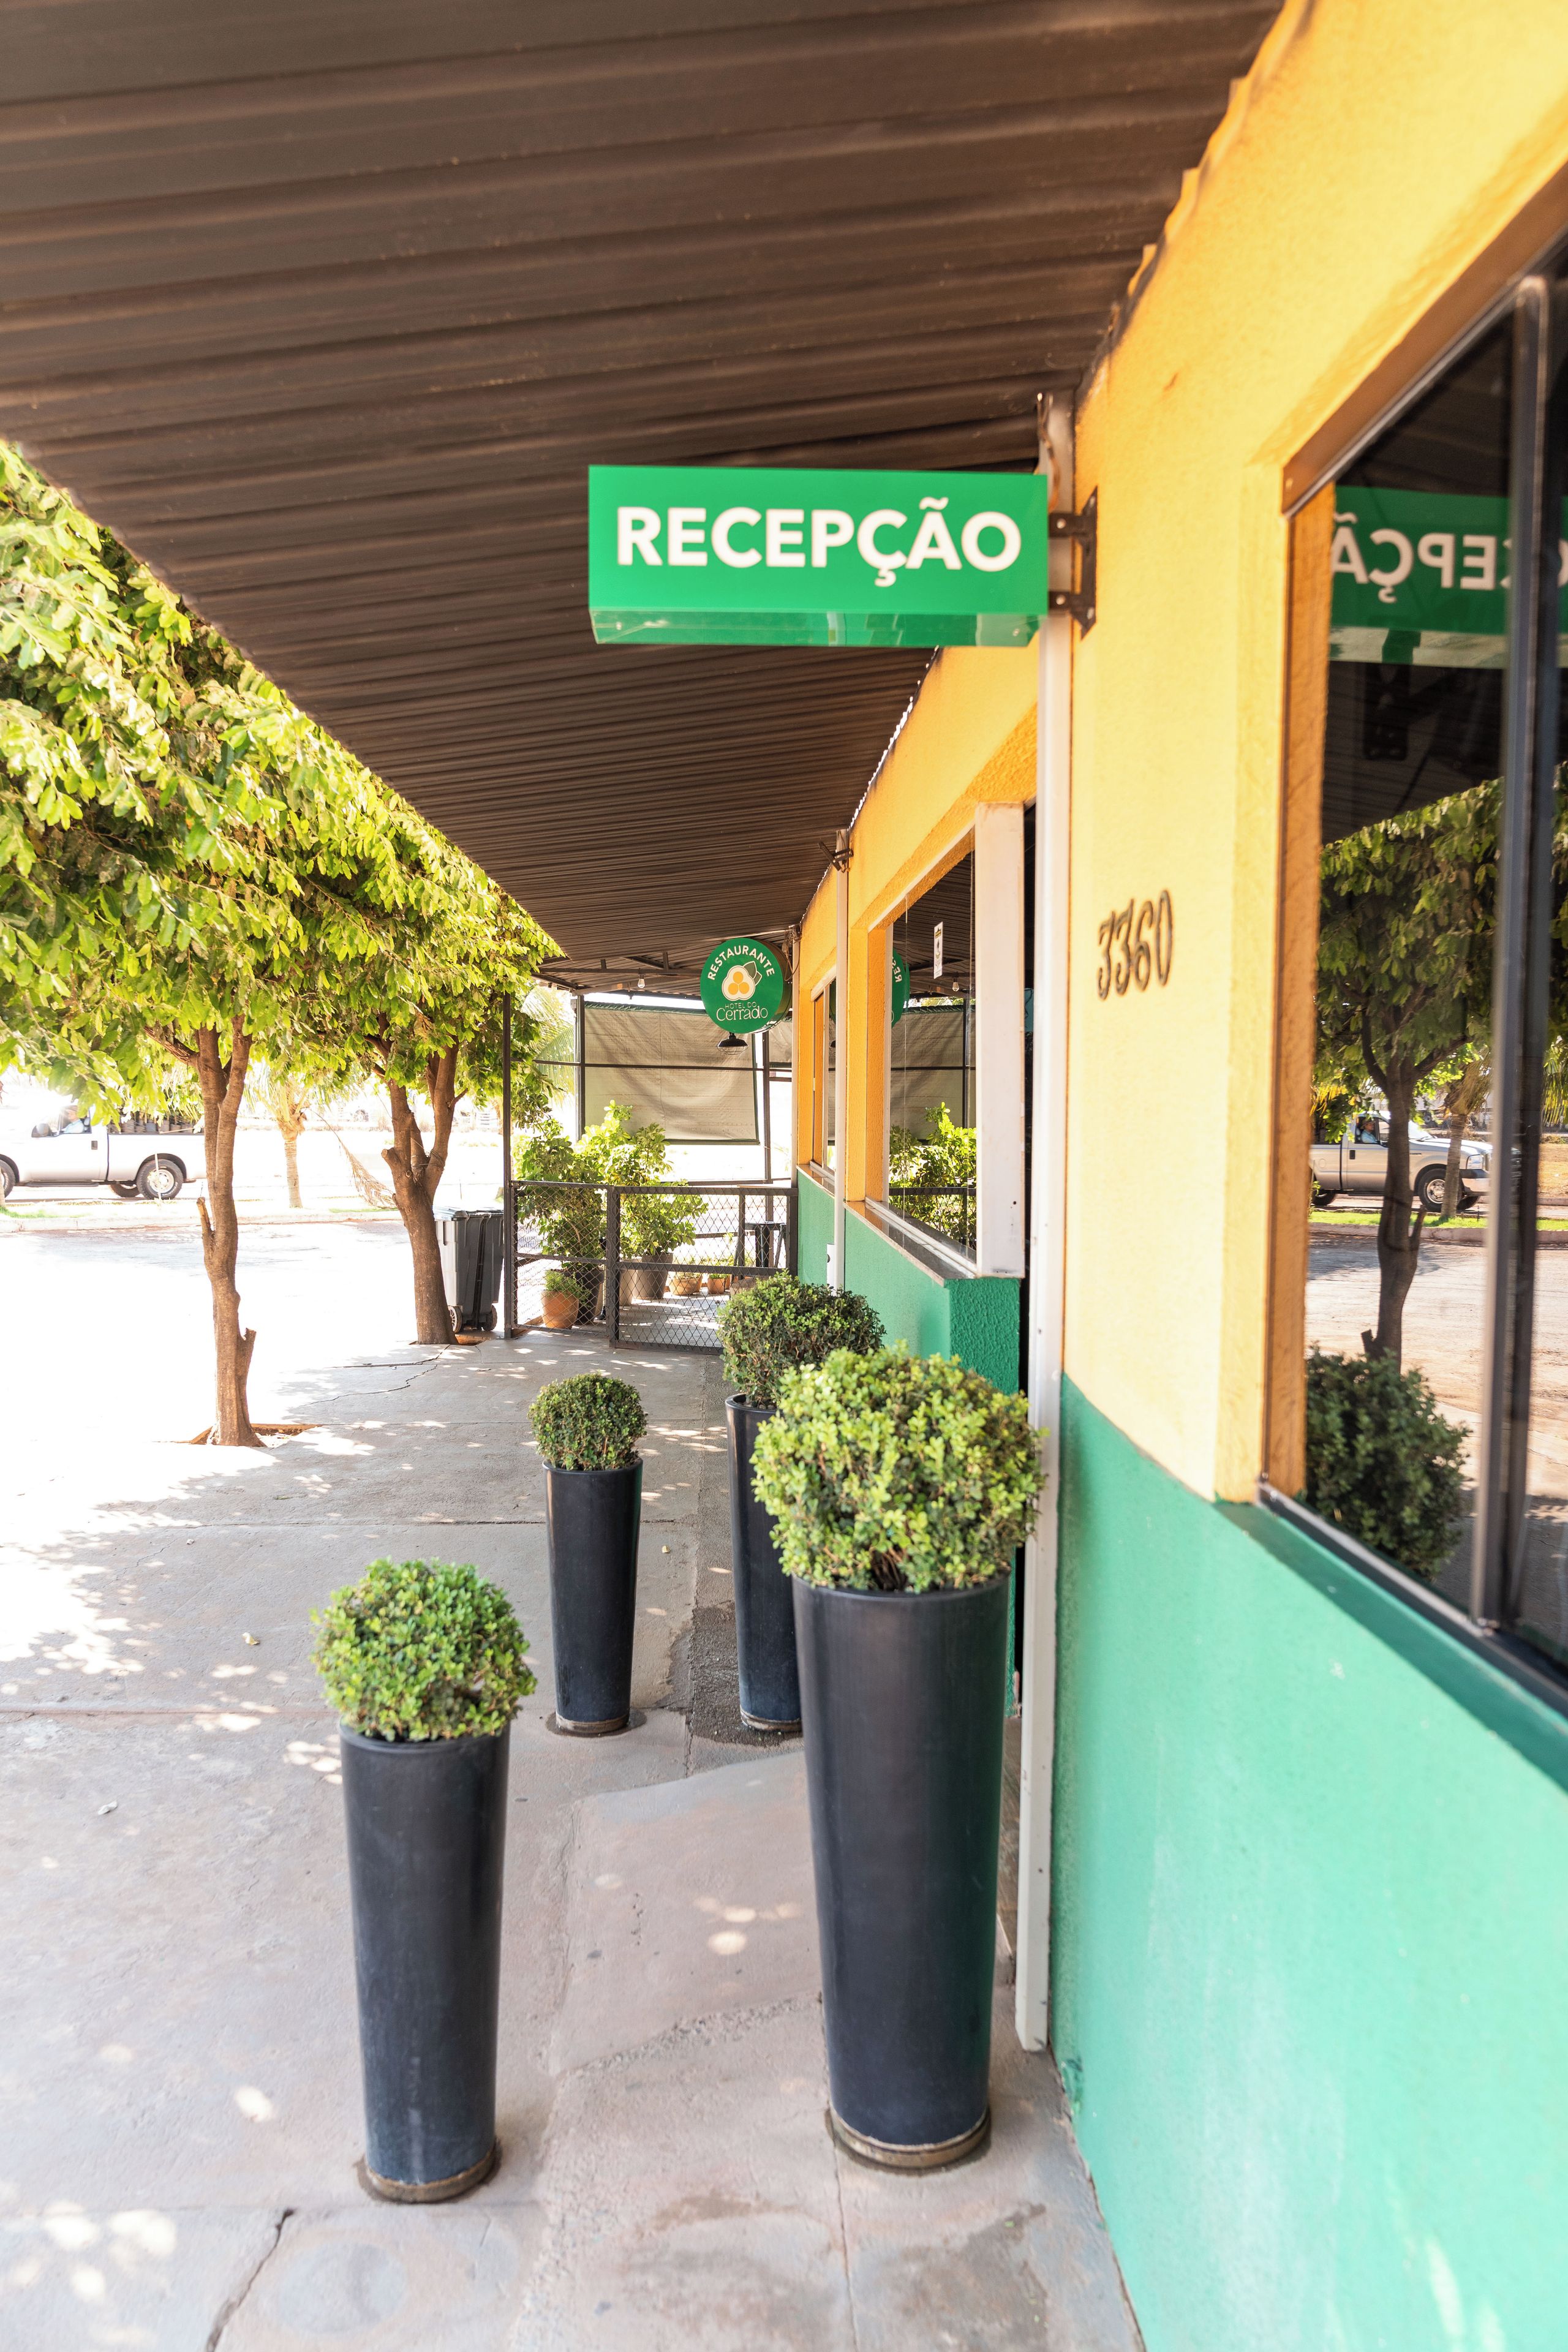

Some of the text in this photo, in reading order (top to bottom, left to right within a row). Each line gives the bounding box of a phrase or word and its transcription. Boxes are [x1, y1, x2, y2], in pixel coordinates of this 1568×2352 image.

[617, 497, 1022, 587] RECEPÇÃO
[707, 945, 775, 980] RESTAURANTE
[1098, 889, 1172, 1000] 3360
[717, 1006, 768, 1021] Cerrado
